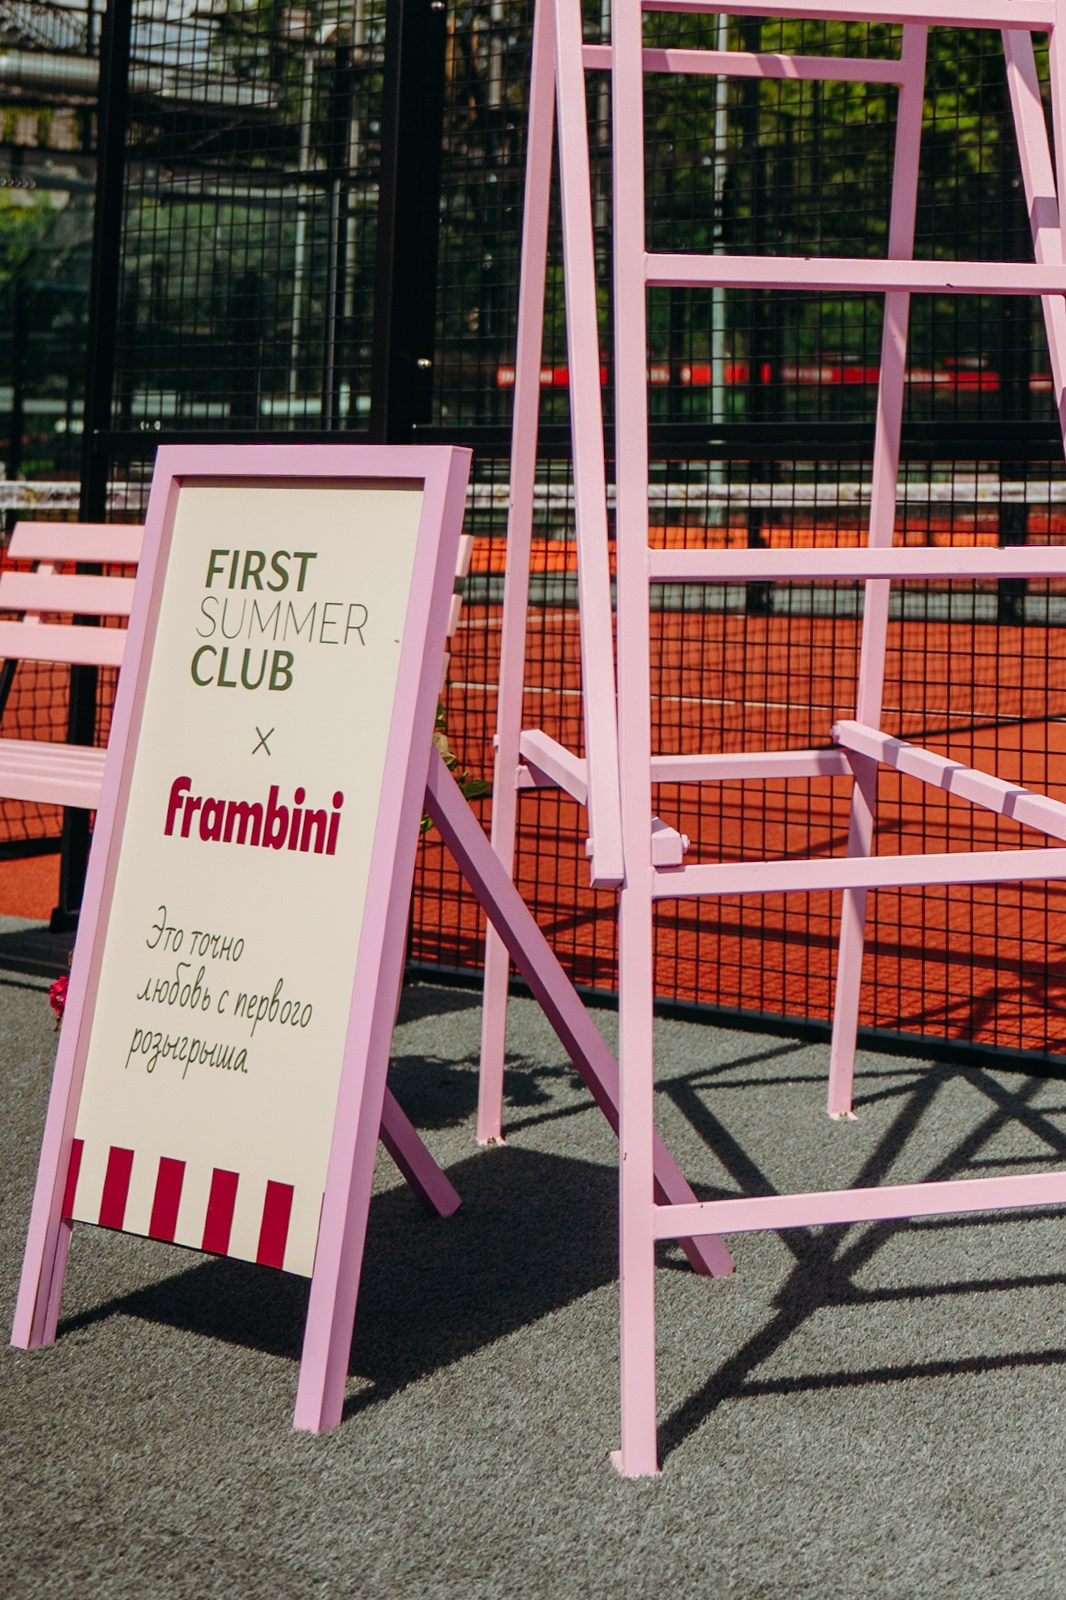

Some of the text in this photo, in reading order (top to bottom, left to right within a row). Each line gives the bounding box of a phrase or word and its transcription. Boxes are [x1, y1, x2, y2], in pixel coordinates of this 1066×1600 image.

[205, 549, 318, 592] FIRST
[195, 595, 369, 646] SUMMER
[190, 644, 295, 692] CLUB
[163, 775, 344, 856] frambini
[146, 905, 245, 962] Это точно
[136, 961, 313, 1038] любовь с первого
[125, 1027, 249, 1080] розыгрыша.
